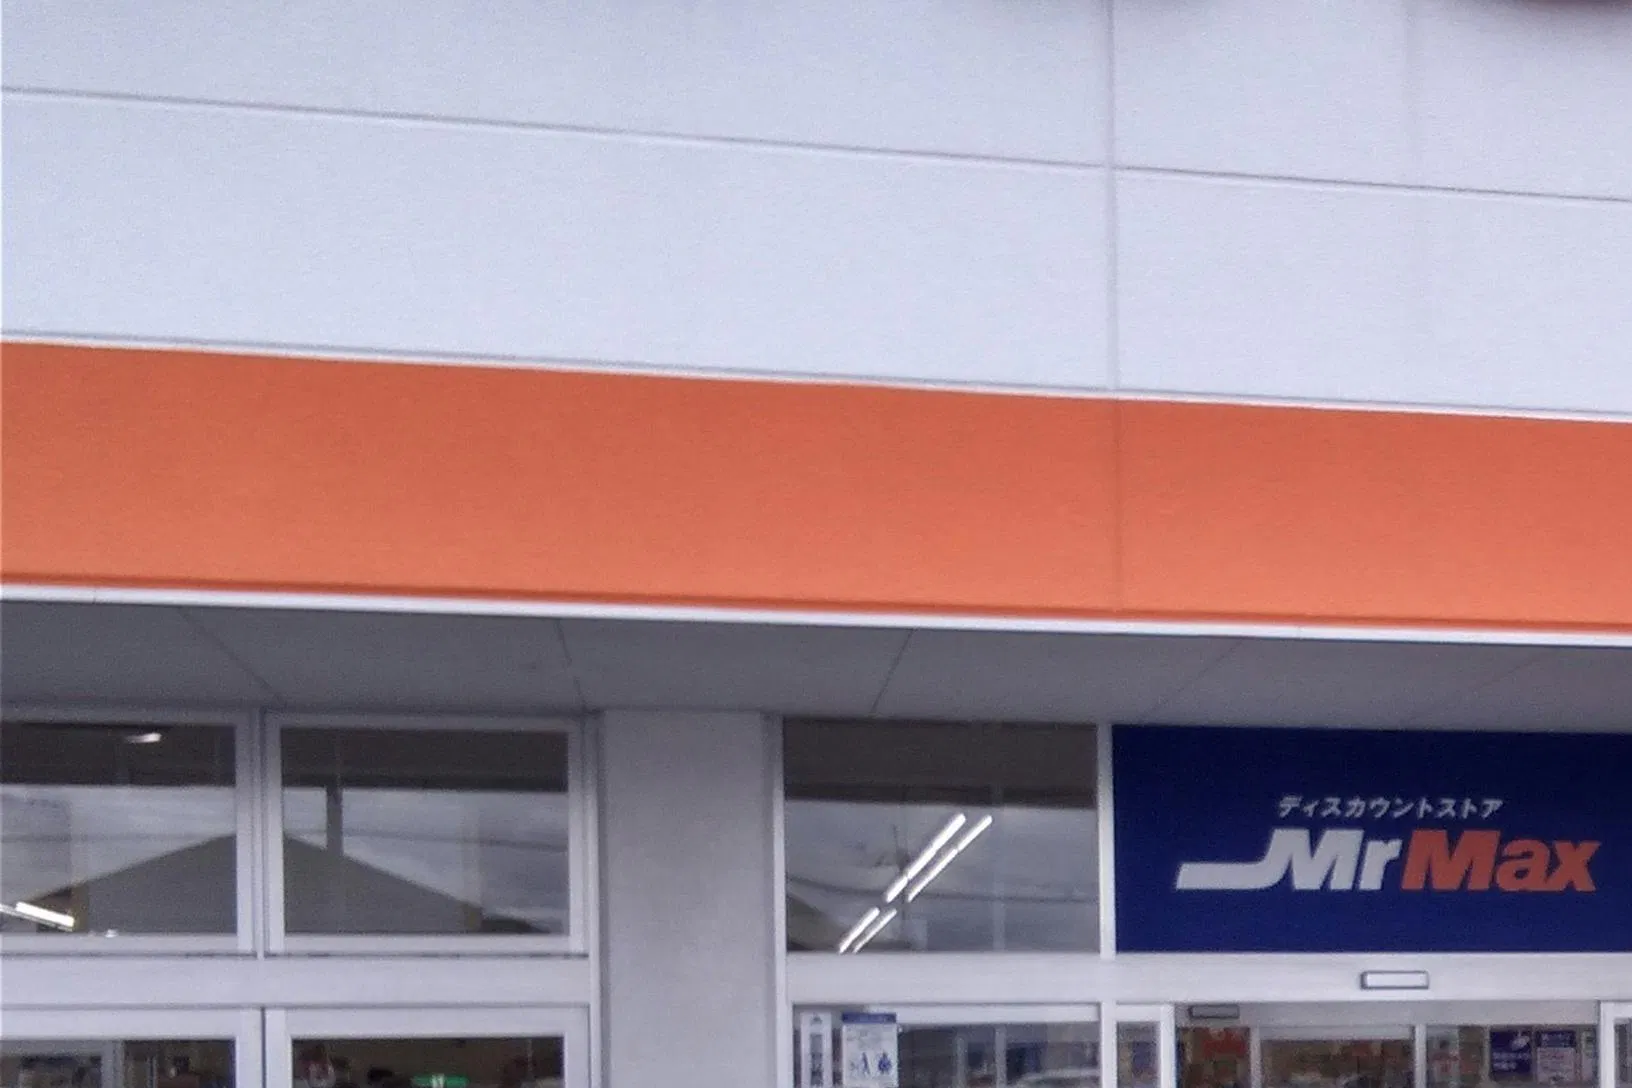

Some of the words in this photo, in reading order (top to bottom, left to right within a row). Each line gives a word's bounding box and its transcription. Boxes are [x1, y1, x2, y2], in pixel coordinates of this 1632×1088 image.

[1278, 796, 1503, 818] ディスカウントストア
[1175, 828, 1600, 892] MrMax
